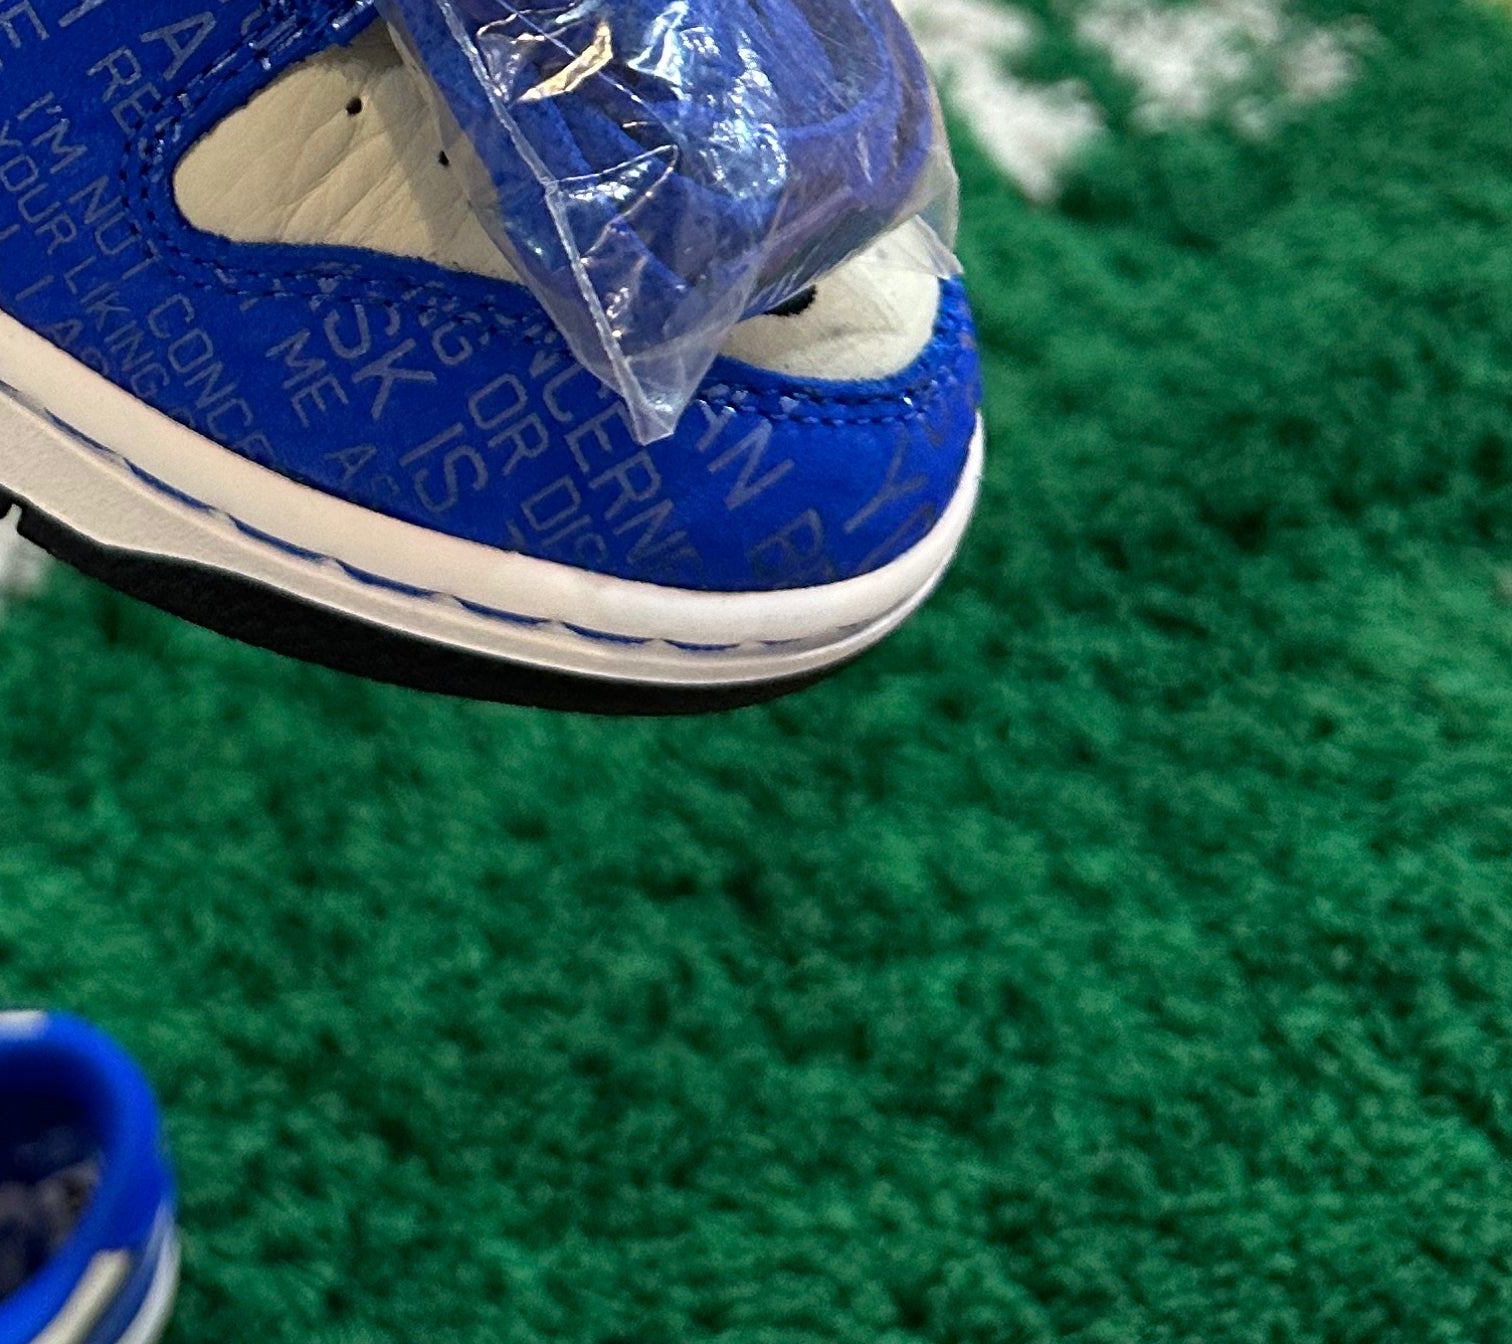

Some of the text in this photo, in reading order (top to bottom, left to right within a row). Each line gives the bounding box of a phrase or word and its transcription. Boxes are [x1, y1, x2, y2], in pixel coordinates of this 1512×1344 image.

[61, 256, 172, 398] LIKING
[264, 328, 347, 429] ME
[396, 421, 485, 514] IS
[466, 371, 550, 477] OR
